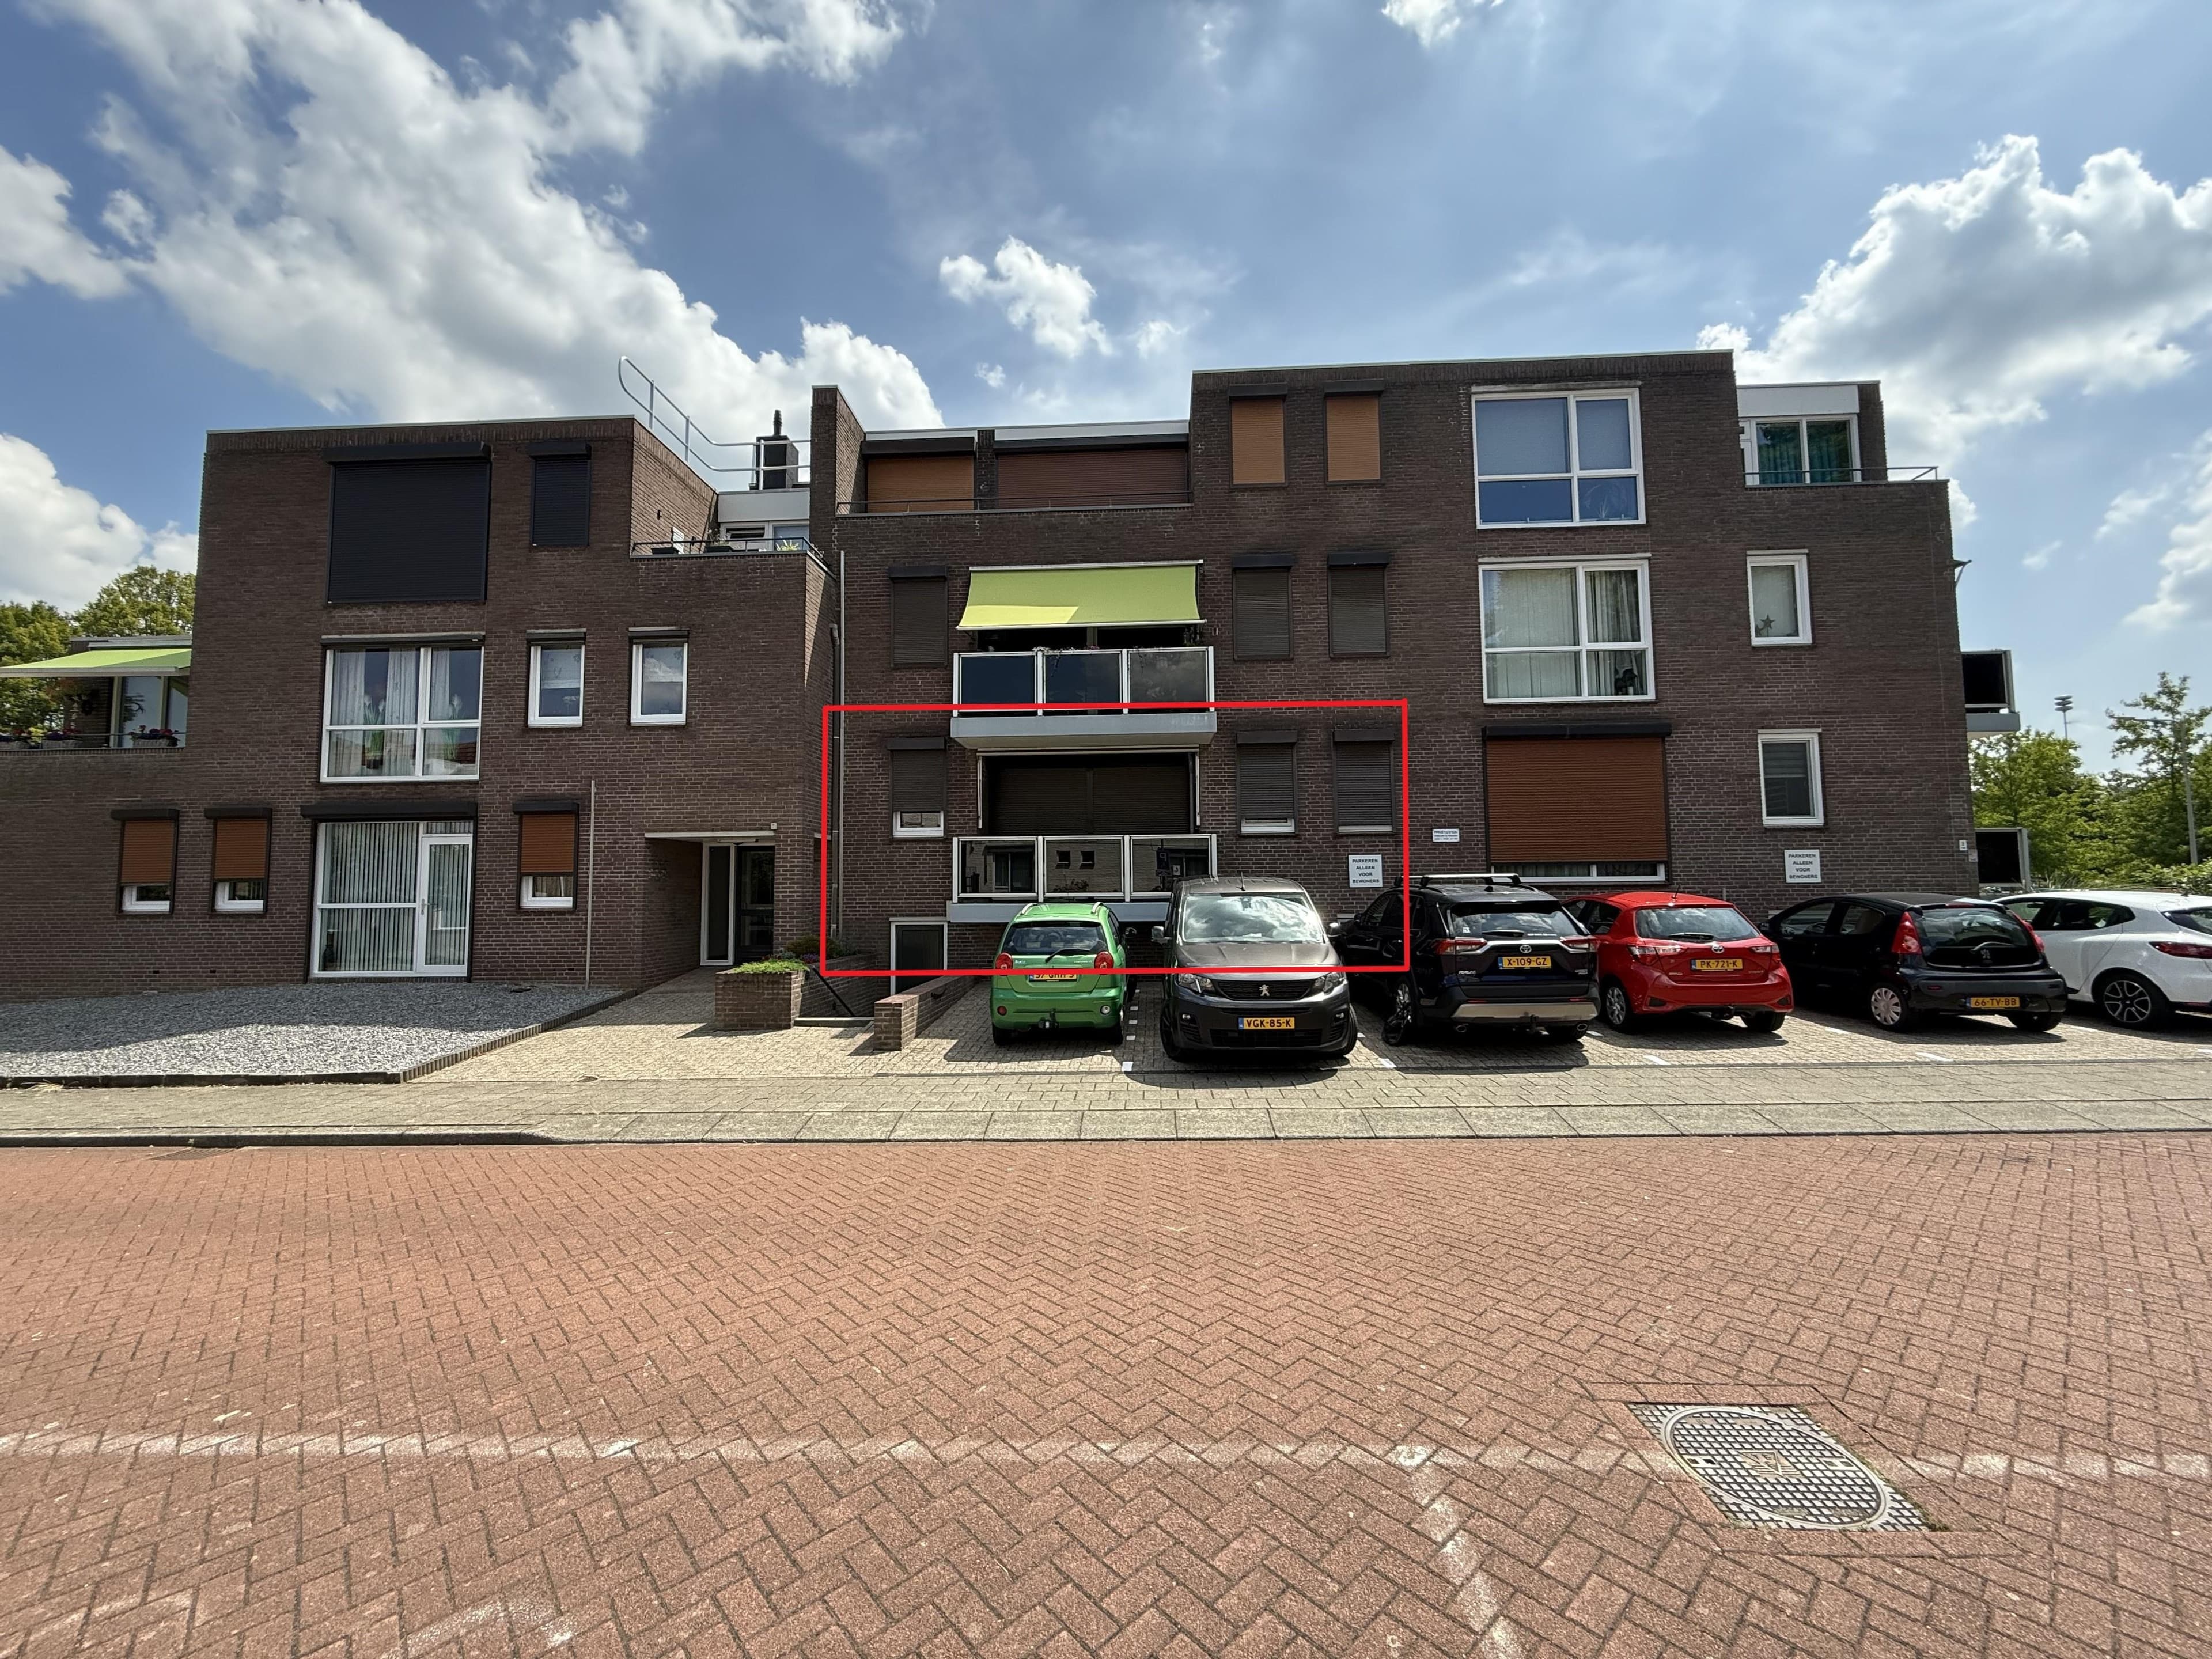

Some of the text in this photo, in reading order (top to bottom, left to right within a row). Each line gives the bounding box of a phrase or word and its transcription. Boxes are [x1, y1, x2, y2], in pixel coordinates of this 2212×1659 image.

[1507, 957, 1547, 966] X-109-GZ
[1700, 960, 1738, 968] PK-721-K
[1975, 998, 2017, 1006] 66-TV-BB
[1247, 1019, 1291, 1028] VGK-85-K
